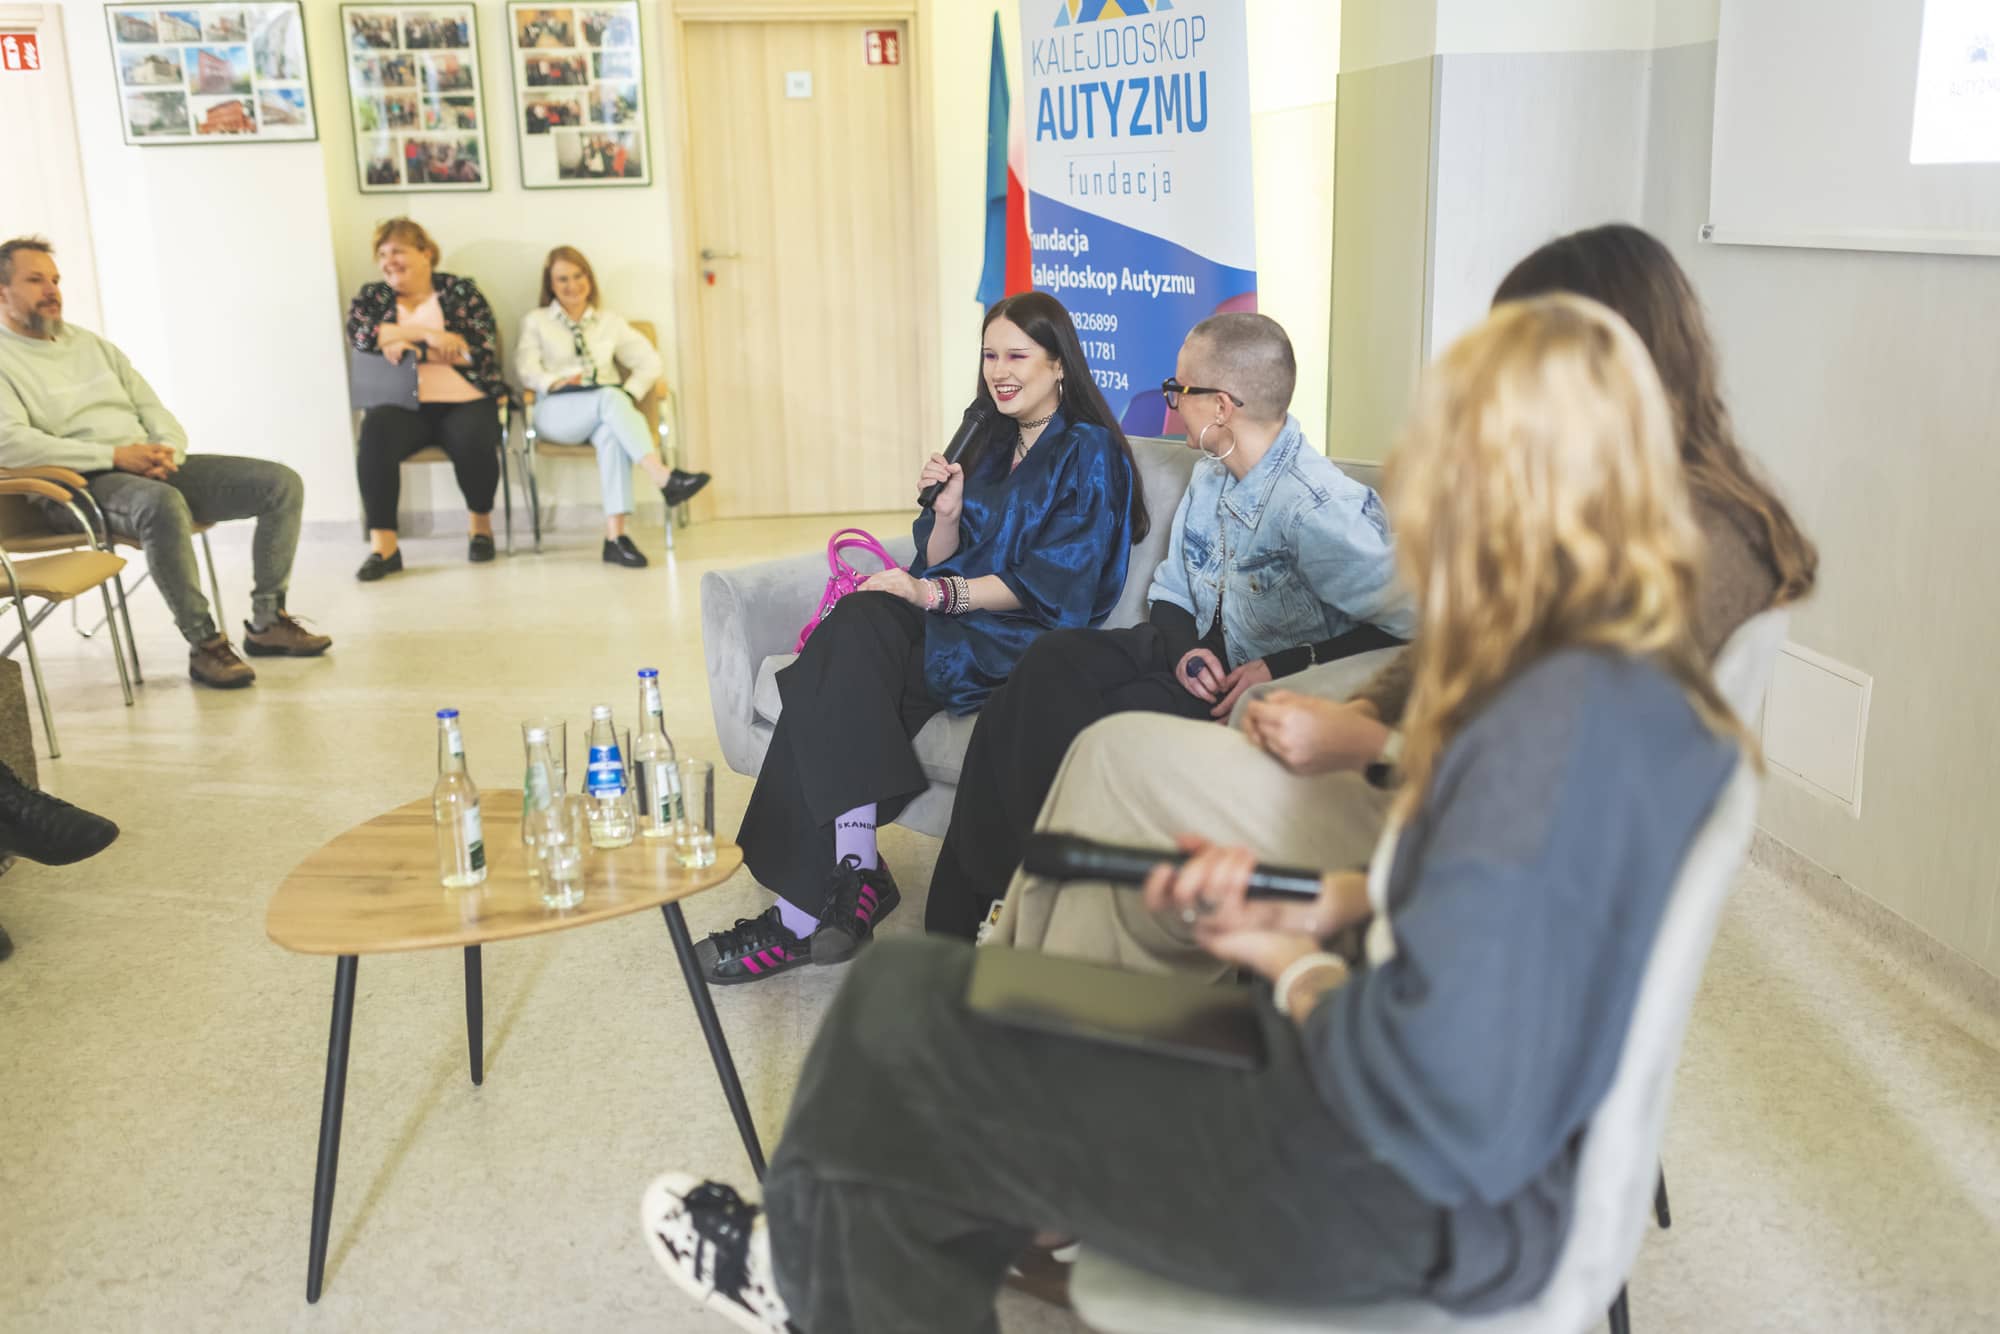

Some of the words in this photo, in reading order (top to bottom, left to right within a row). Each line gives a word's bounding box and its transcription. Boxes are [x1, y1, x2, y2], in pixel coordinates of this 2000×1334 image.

[1032, 15, 1206, 77] KALEJDOSKOP
[1036, 70, 1208, 142] AUTYZMU
[1069, 160, 1172, 202] fundacja
[1120, 267, 1196, 299] Autyzmu
[1079, 340, 1116, 361] 11781
[1089, 368, 1129, 391] 73734
